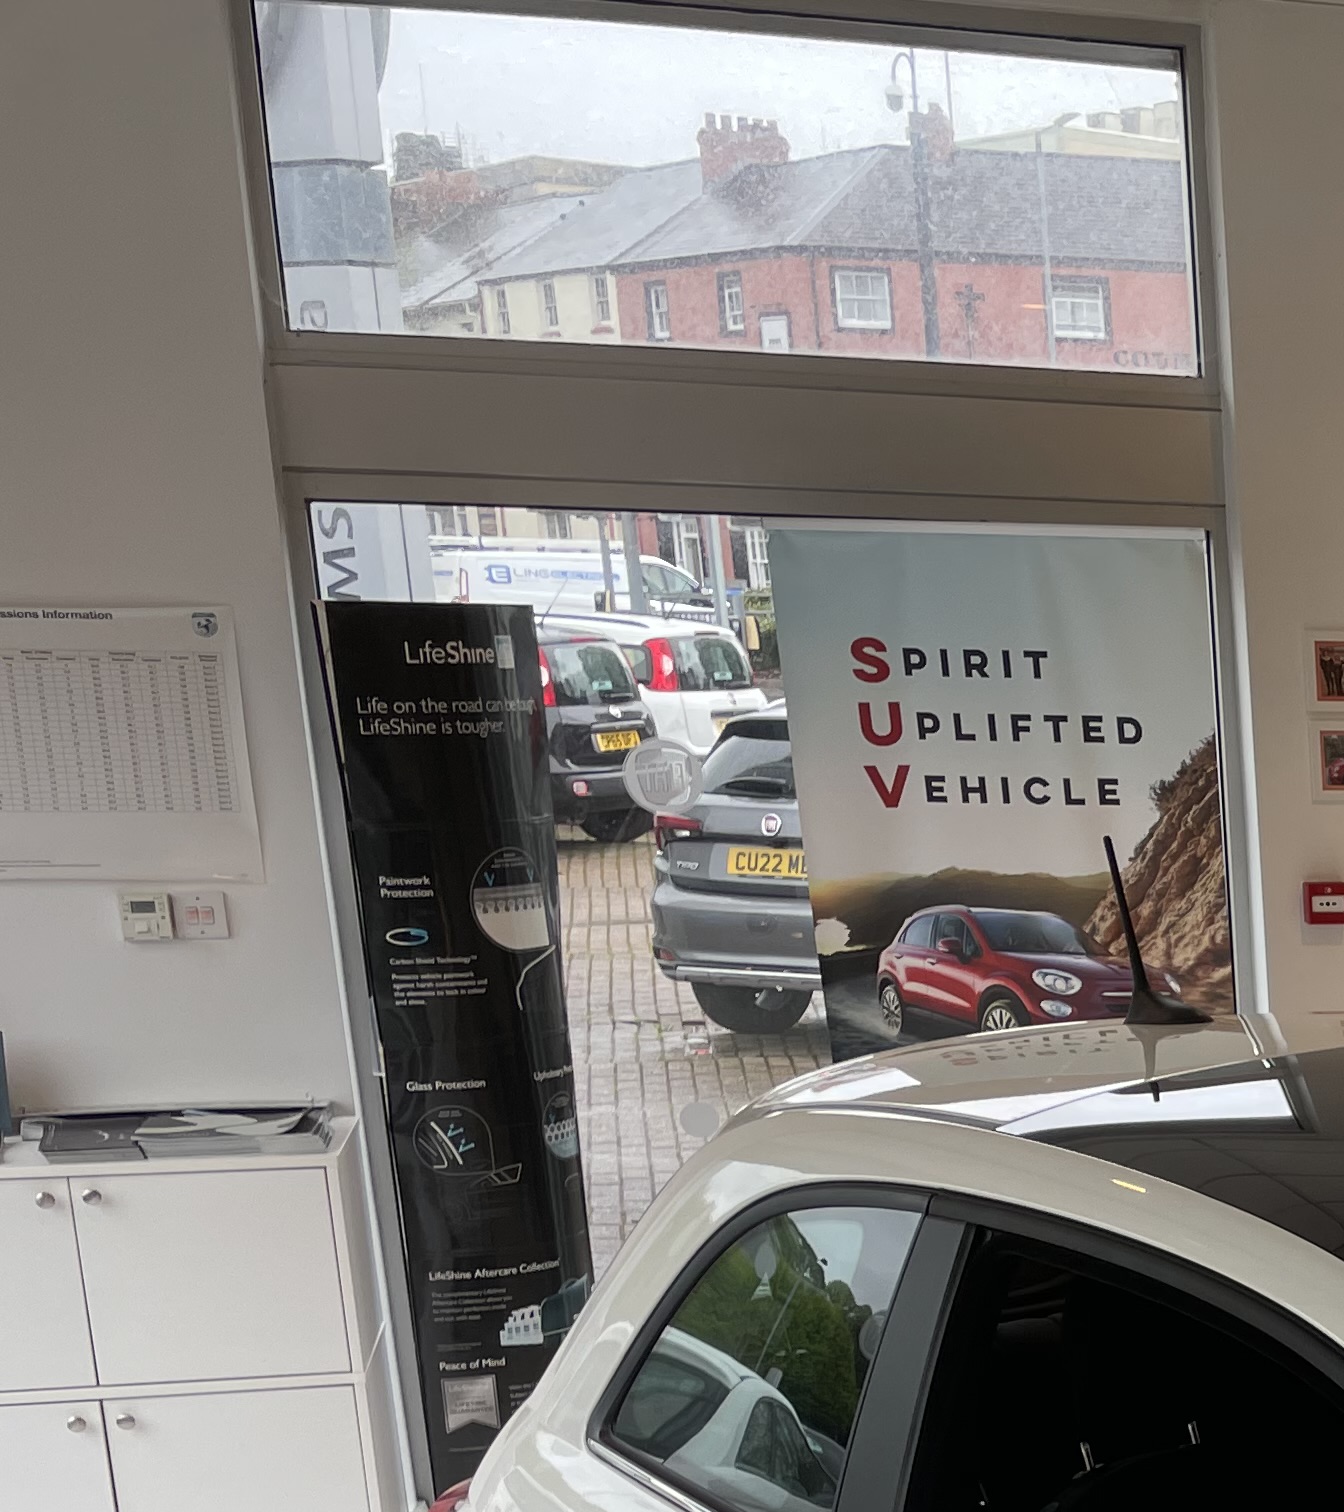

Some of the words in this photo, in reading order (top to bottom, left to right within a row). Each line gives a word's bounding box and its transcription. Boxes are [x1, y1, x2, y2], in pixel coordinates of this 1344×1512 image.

[42, 609, 113, 620] Information
[403, 640, 494, 664] LifeShine
[850, 637, 1048, 683] SPIRIT
[356, 696, 388, 714] Life
[393, 701, 416, 715] on
[421, 697, 448, 714] the
[452, 696, 483, 713] road
[359, 718, 436, 736] LifeShine
[441, 718, 453, 735] is
[858, 701, 1143, 747] UPLIFTED
[864, 764, 1121, 809] VEHICLE
[735, 851, 783, 873] CU22
[378, 875, 431, 887] Paintwork
[380, 888, 434, 899] Protection
[406, 1080, 432, 1092] Glass
[435, 1078, 486, 1091] Protection
[428, 1269, 471, 1282] LifeShine
[474, 1266, 517, 1279] Aftercare
[439, 1360, 467, 1371] Peace
[469, 1359, 479, 1369] of
[482, 1356, 506, 1368] Mind
